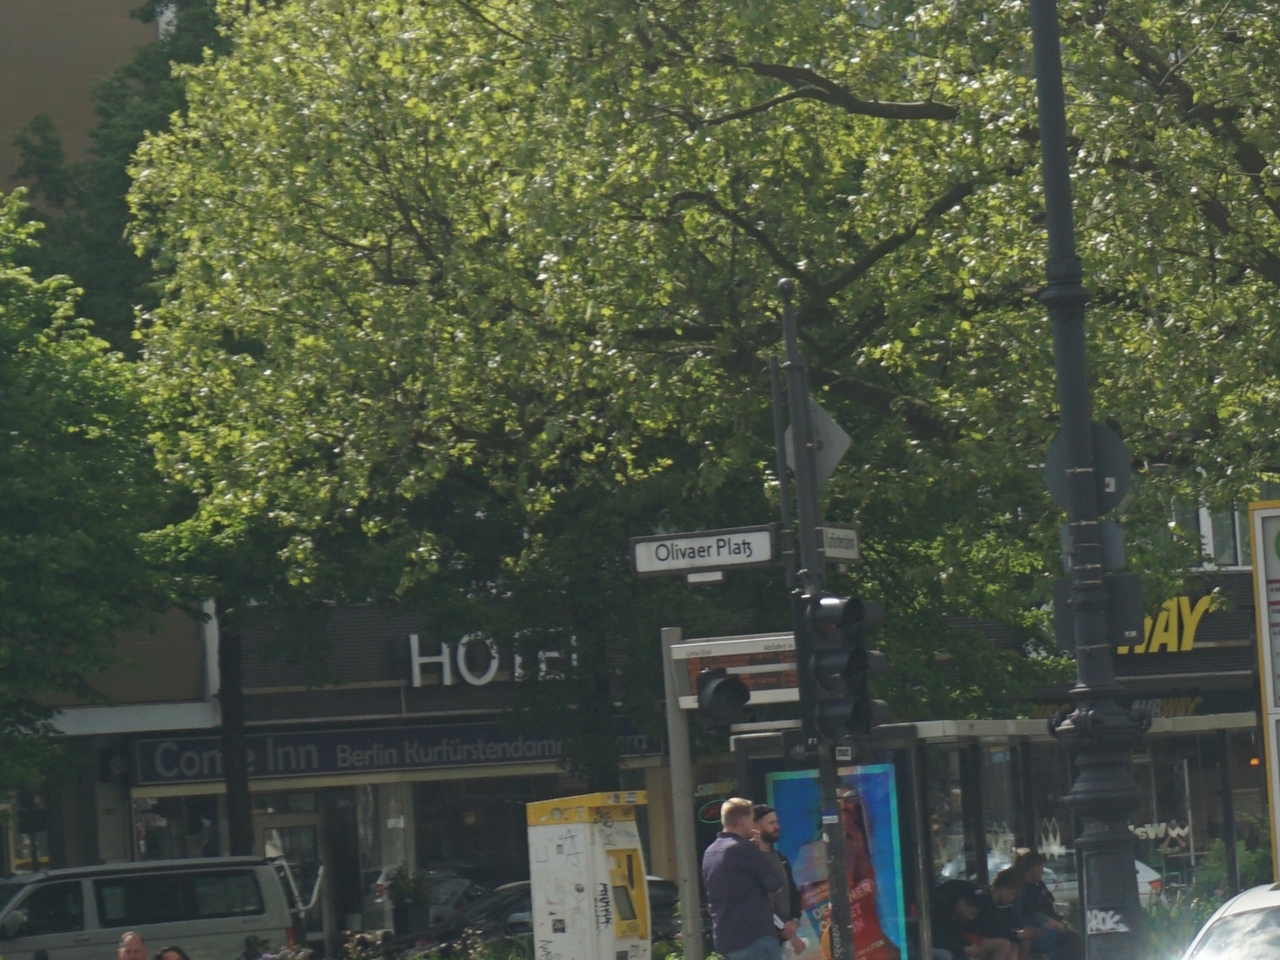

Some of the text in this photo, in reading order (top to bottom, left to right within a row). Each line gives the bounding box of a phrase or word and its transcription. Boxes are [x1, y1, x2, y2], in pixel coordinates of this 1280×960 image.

[654, 538, 753, 562] Olivaer Platz
[266, 736, 319, 771] Inn
[336, 743, 398, 768] Berlin
